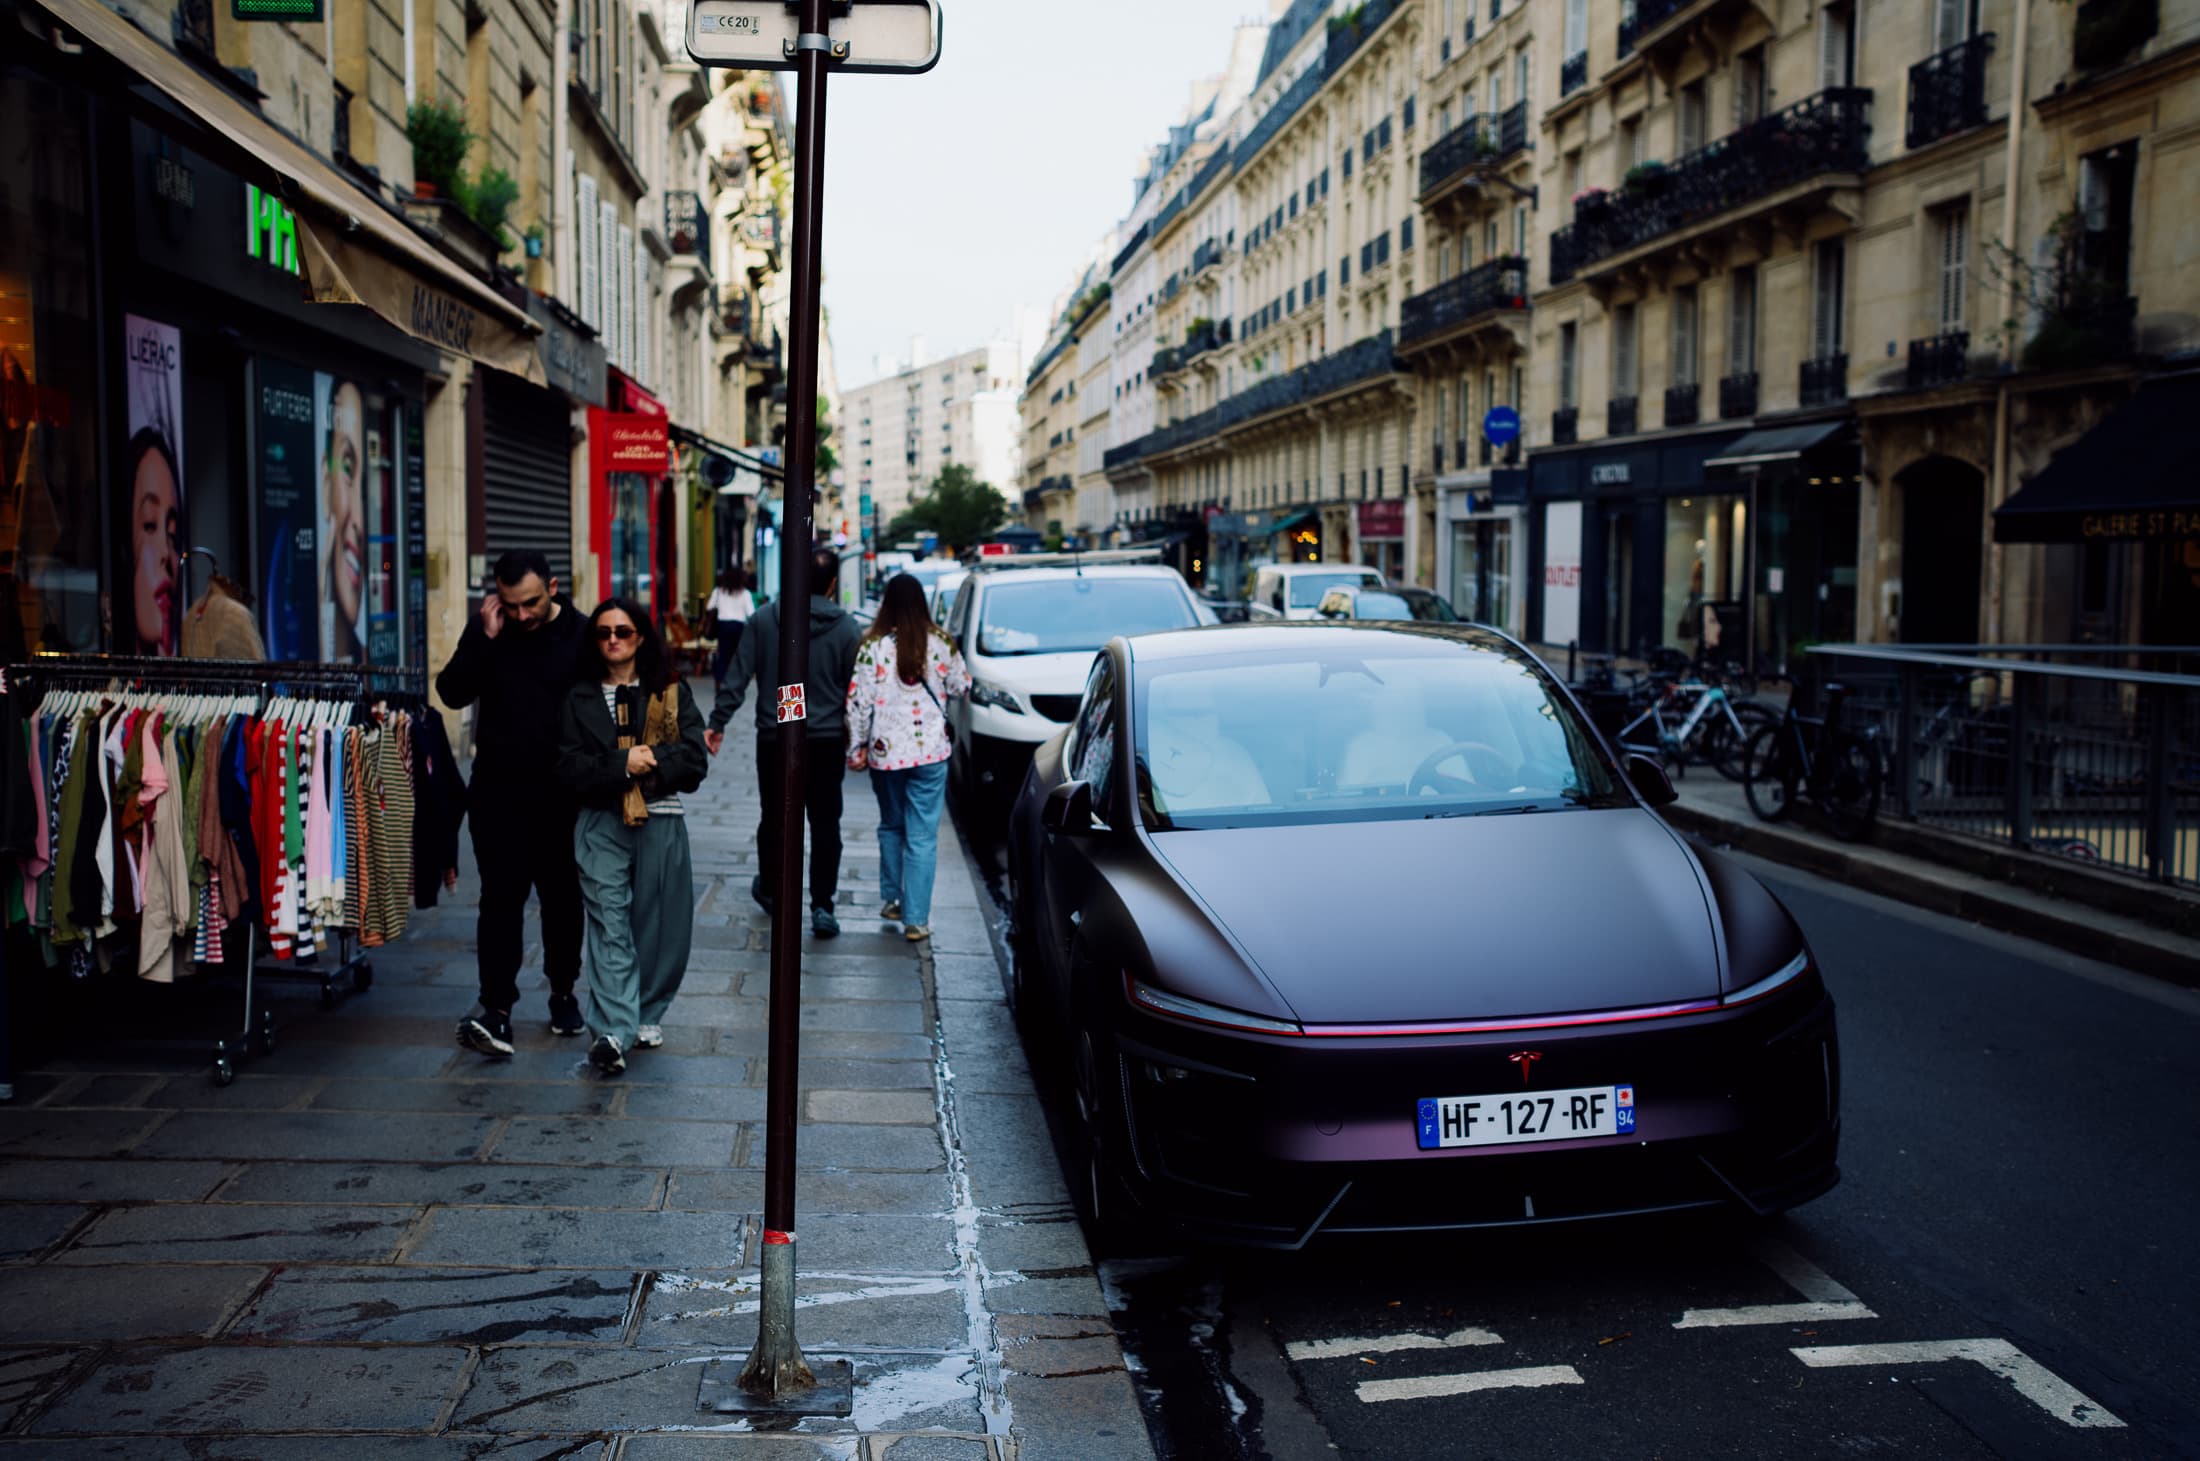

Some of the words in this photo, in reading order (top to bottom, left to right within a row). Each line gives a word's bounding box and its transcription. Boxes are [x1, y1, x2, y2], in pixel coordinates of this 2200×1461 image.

[245, 180, 300, 277] PH
[2081, 513, 2142, 538] GALERIE
[2147, 511, 2167, 537] ST
[1443, 1093, 1608, 1139] HF-127-RF
[1617, 1109, 1635, 1126] 94
[1425, 1124, 1432, 1136] F
